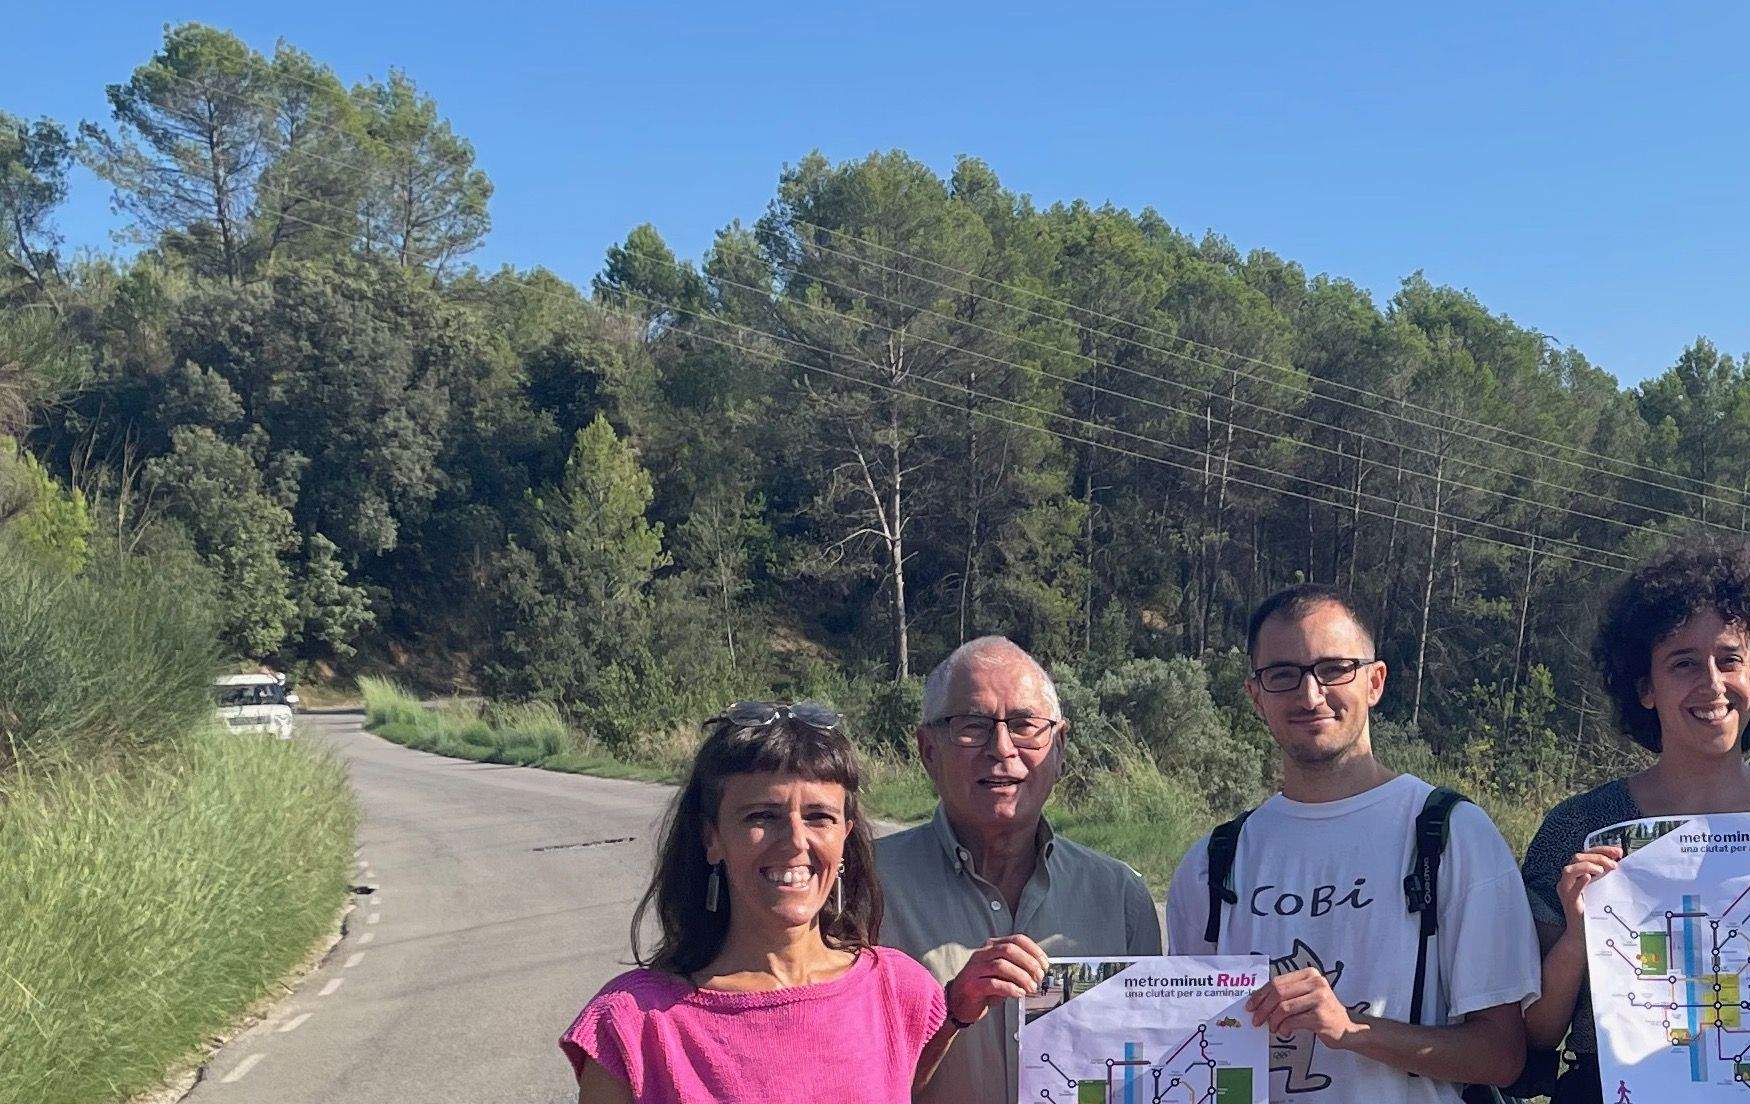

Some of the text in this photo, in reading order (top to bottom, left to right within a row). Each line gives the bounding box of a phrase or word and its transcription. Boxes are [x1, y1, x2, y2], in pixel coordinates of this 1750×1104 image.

[1730, 845, 1746, 853] per
[1124, 973, 1257, 987] metrominut Rubí
[1145, 989, 1175, 998] ciutat
[1177, 990, 1194, 998] per
